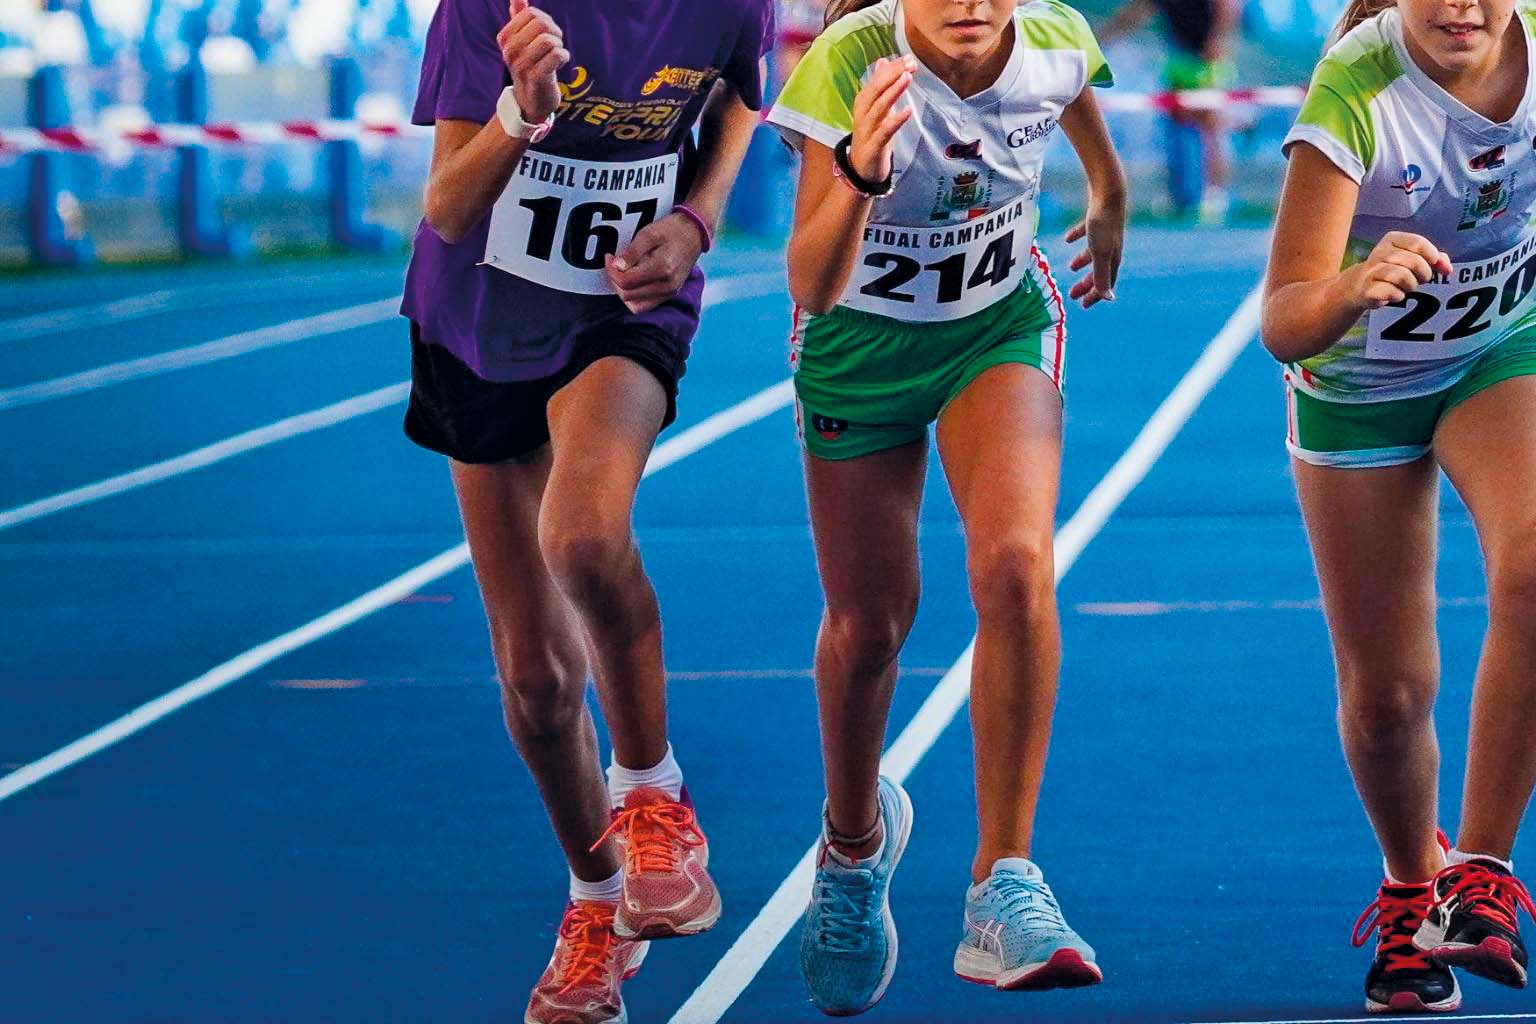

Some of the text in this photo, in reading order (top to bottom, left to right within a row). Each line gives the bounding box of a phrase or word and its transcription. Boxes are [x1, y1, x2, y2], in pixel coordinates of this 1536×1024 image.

[519, 155, 666, 192] FIDAL CAMPANIA
[519, 195, 659, 271] 167
[863, 201, 1024, 249] FIDAL CAMPANIA
[859, 228, 1017, 304] 214
